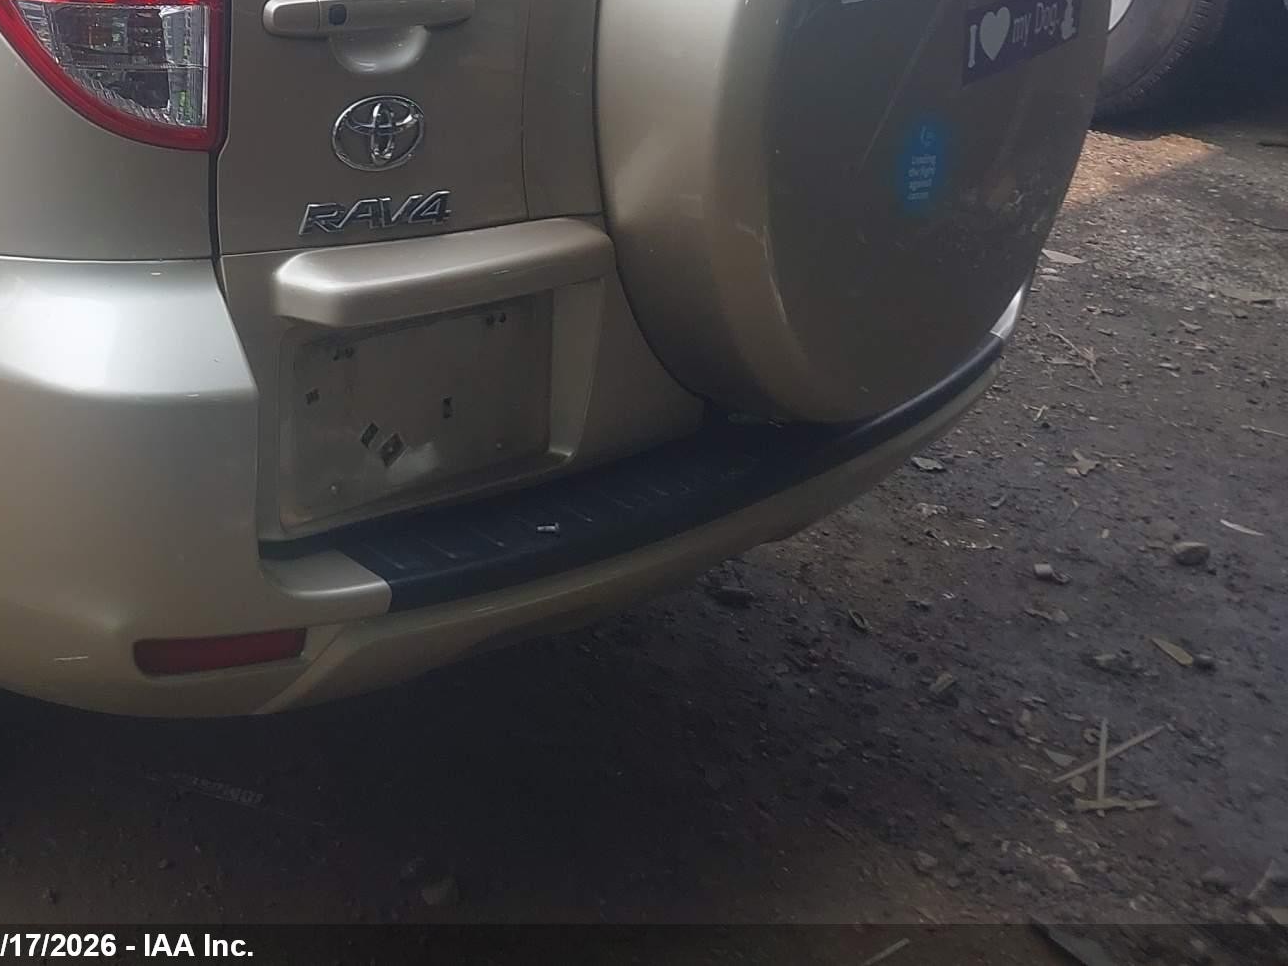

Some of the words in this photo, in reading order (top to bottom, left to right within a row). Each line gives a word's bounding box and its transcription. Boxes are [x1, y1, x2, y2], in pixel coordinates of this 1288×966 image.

[967, 24, 978, 68] I
[1011, 13, 1032, 47] my
[298, 190, 451, 235] RAV4
